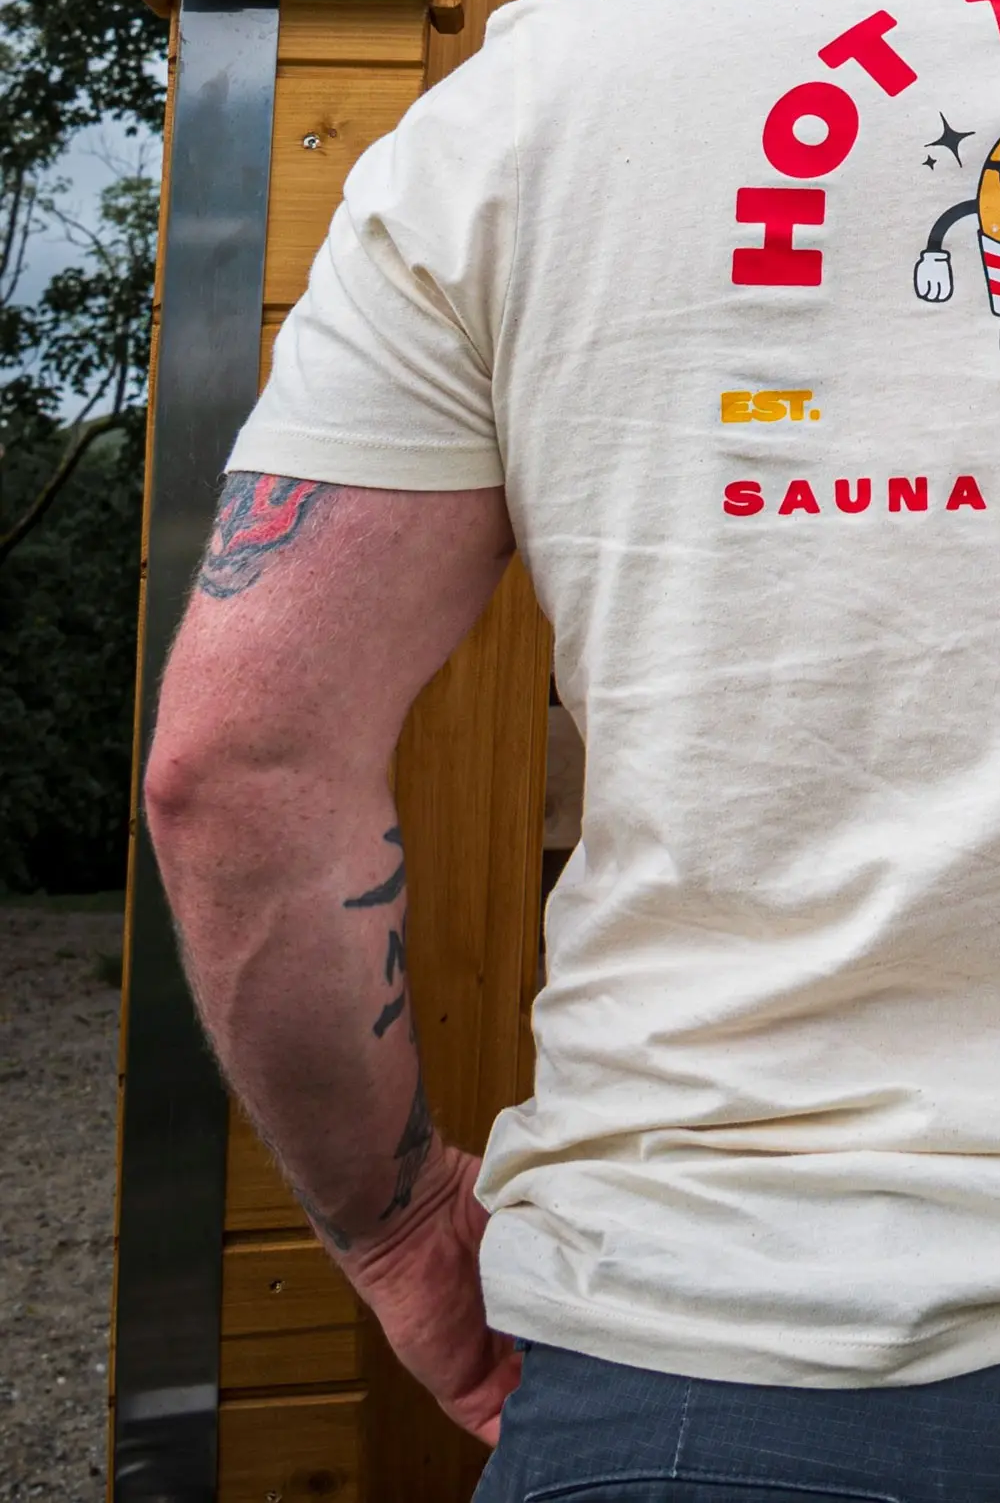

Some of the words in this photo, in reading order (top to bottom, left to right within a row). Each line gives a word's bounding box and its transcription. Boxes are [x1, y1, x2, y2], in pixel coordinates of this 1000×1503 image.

[731, 9, 918, 287] HOT
[720, 389, 821, 424] EST.
[723, 474, 987, 517] SAUNA
